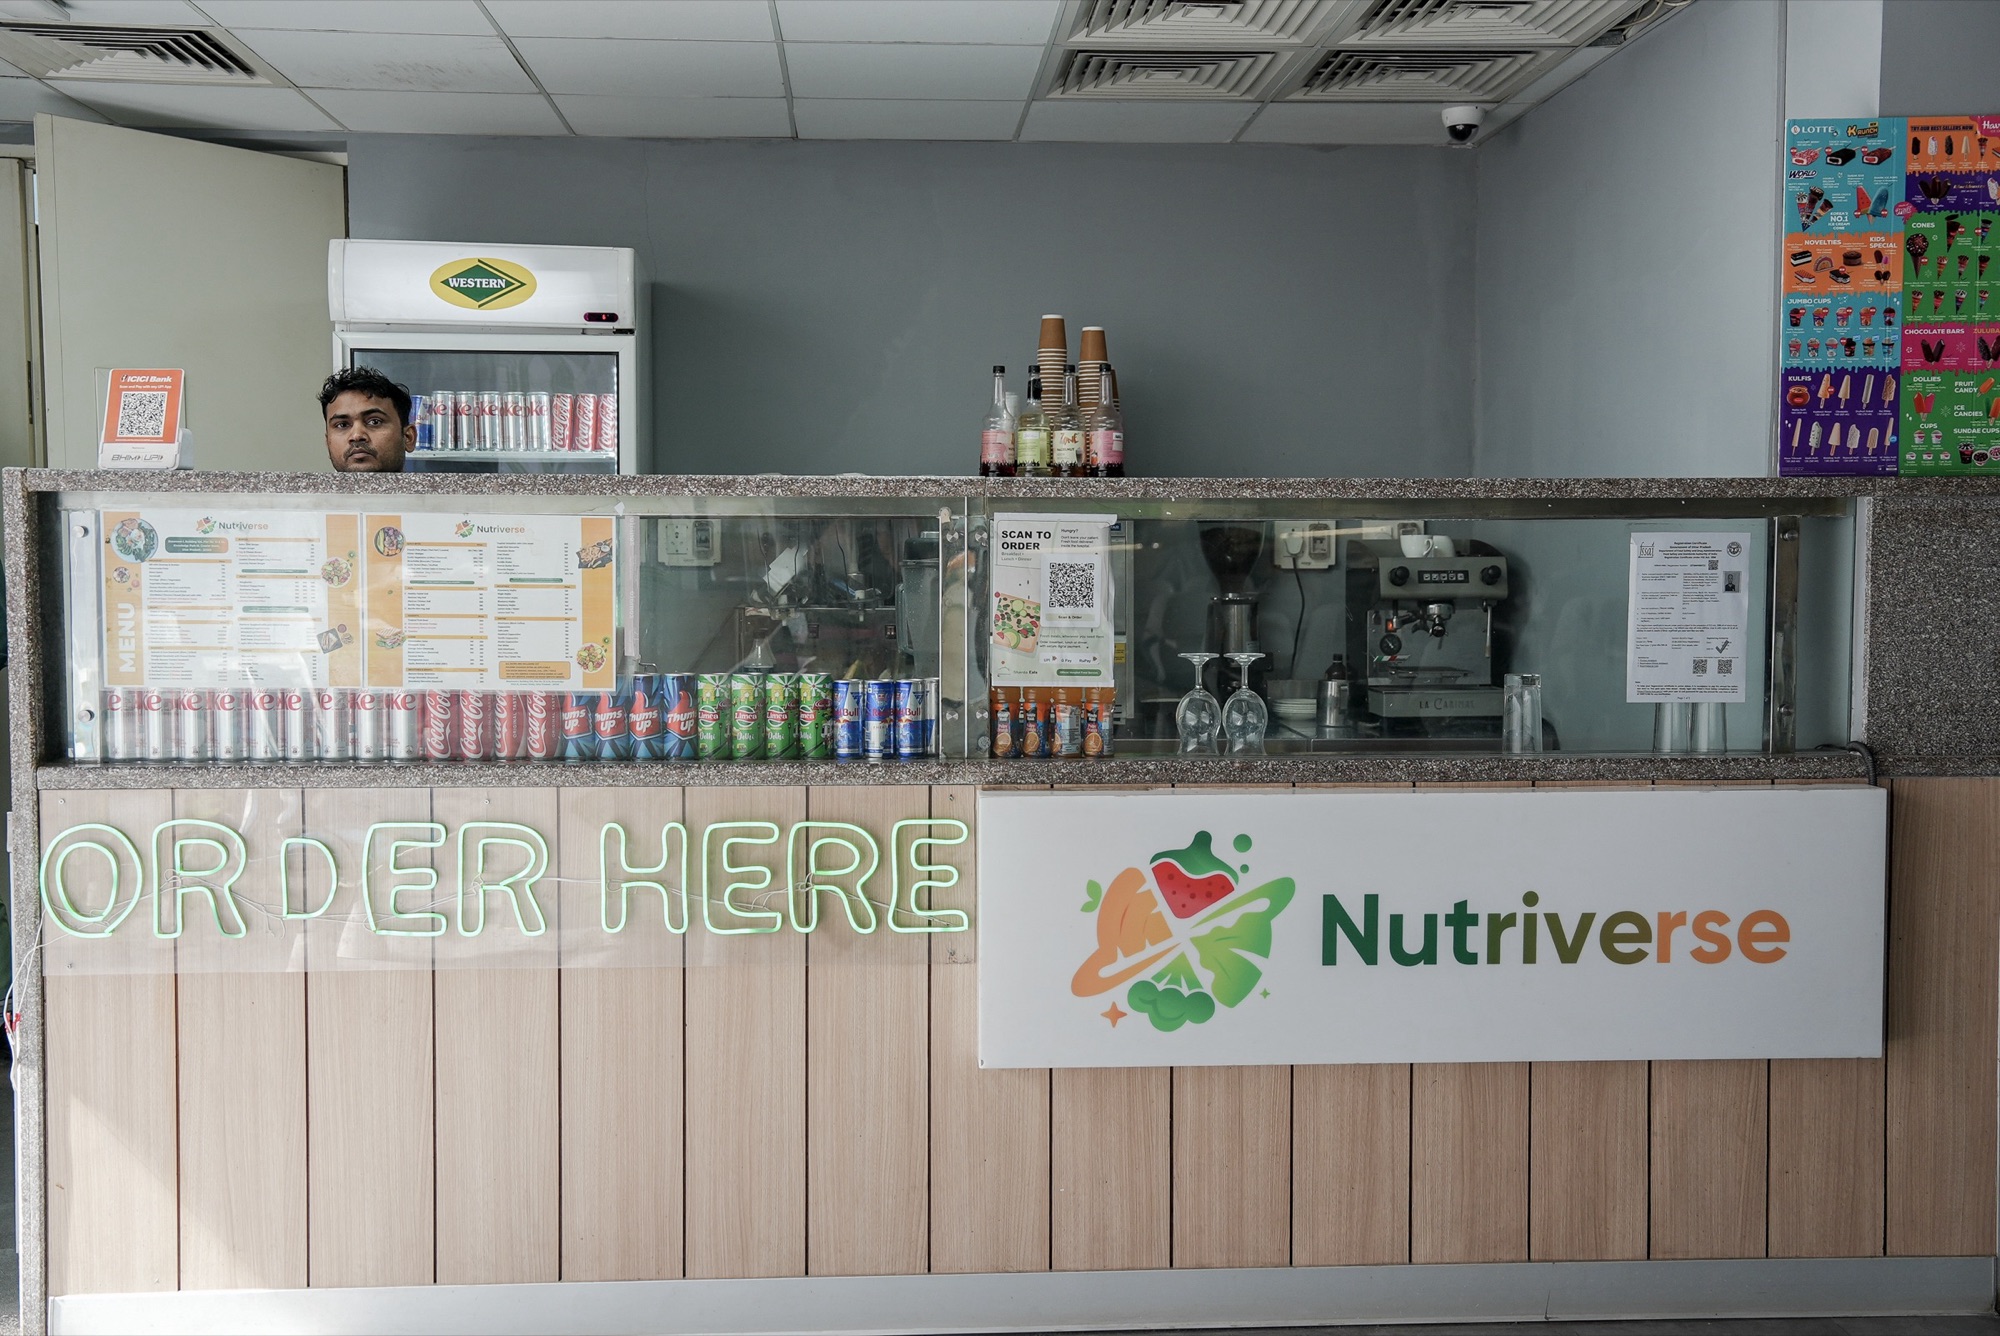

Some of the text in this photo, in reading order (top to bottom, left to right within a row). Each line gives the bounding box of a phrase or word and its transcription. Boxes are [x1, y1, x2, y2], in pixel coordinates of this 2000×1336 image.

[1982, 120, 2000, 130] Hav
[1801, 126, 1835, 134] LOTTE
[1788, 170, 1817, 179] WORLD
[448, 277, 506, 288] WESTERN
[218, 521, 269, 530] Nutriverse
[477, 525, 526, 534] Nutriverse
[1001, 530, 1052, 539] SCAN TO
[1001, 541, 1040, 550] ORDER
[117, 602, 136, 674] MENU
[843, 708, 859, 717] Bull
[905, 708, 921, 717] Bull
[426, 688, 451, 758] Coca-Co
[460, 688, 484, 758] Coca-Co
[40, 818, 969, 938] ORDER HERE
[1321, 890, 1792, 968] Nutriverse
